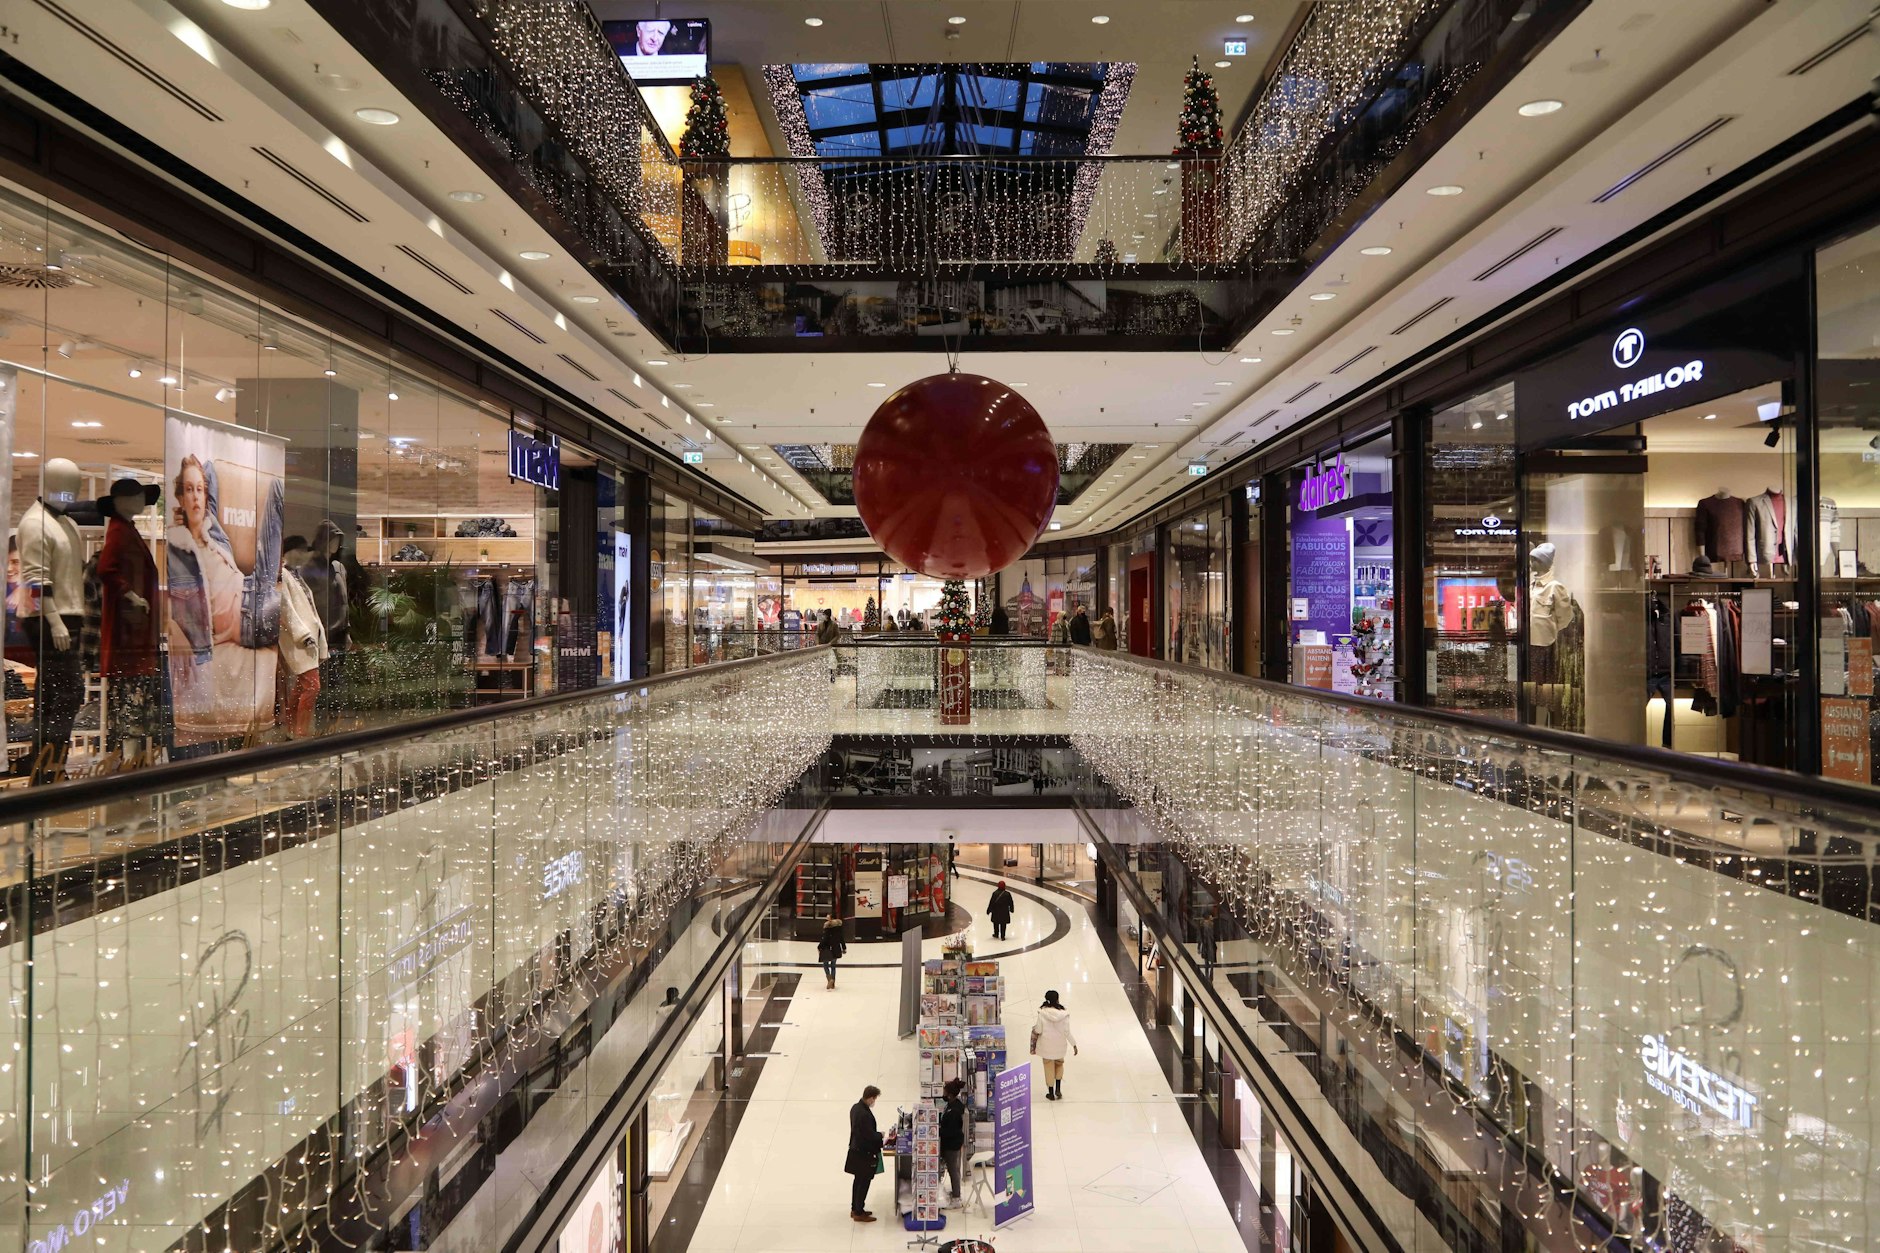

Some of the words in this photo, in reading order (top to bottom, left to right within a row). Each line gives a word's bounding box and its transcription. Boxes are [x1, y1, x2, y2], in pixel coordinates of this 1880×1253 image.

[1567, 390, 1618, 420] TOM
[1619, 359, 1704, 403] TAILOR
[509, 430, 559, 491] mavi
[1299, 451, 1347, 511] claire's
[223, 505, 257, 527] mavi
[1455, 528, 1486, 536] TOM
[618, 544, 628, 558] mavi
[1295, 542, 1347, 551] FABULOUS
[1295, 566, 1346, 575] FABULOSA
[1296, 585, 1347, 594] FABULOUS
[1308, 609, 1347, 618] BULOSA
[560, 646, 592, 657] mavi
[1824, 705, 1863, 720] ABSTAND
[1823, 723, 1860, 738] HALTEN!
[1000, 1079, 1014, 1089] Scan
[1014, 1075, 1018, 1084] &
[1018, 1073, 1027, 1081] Go
